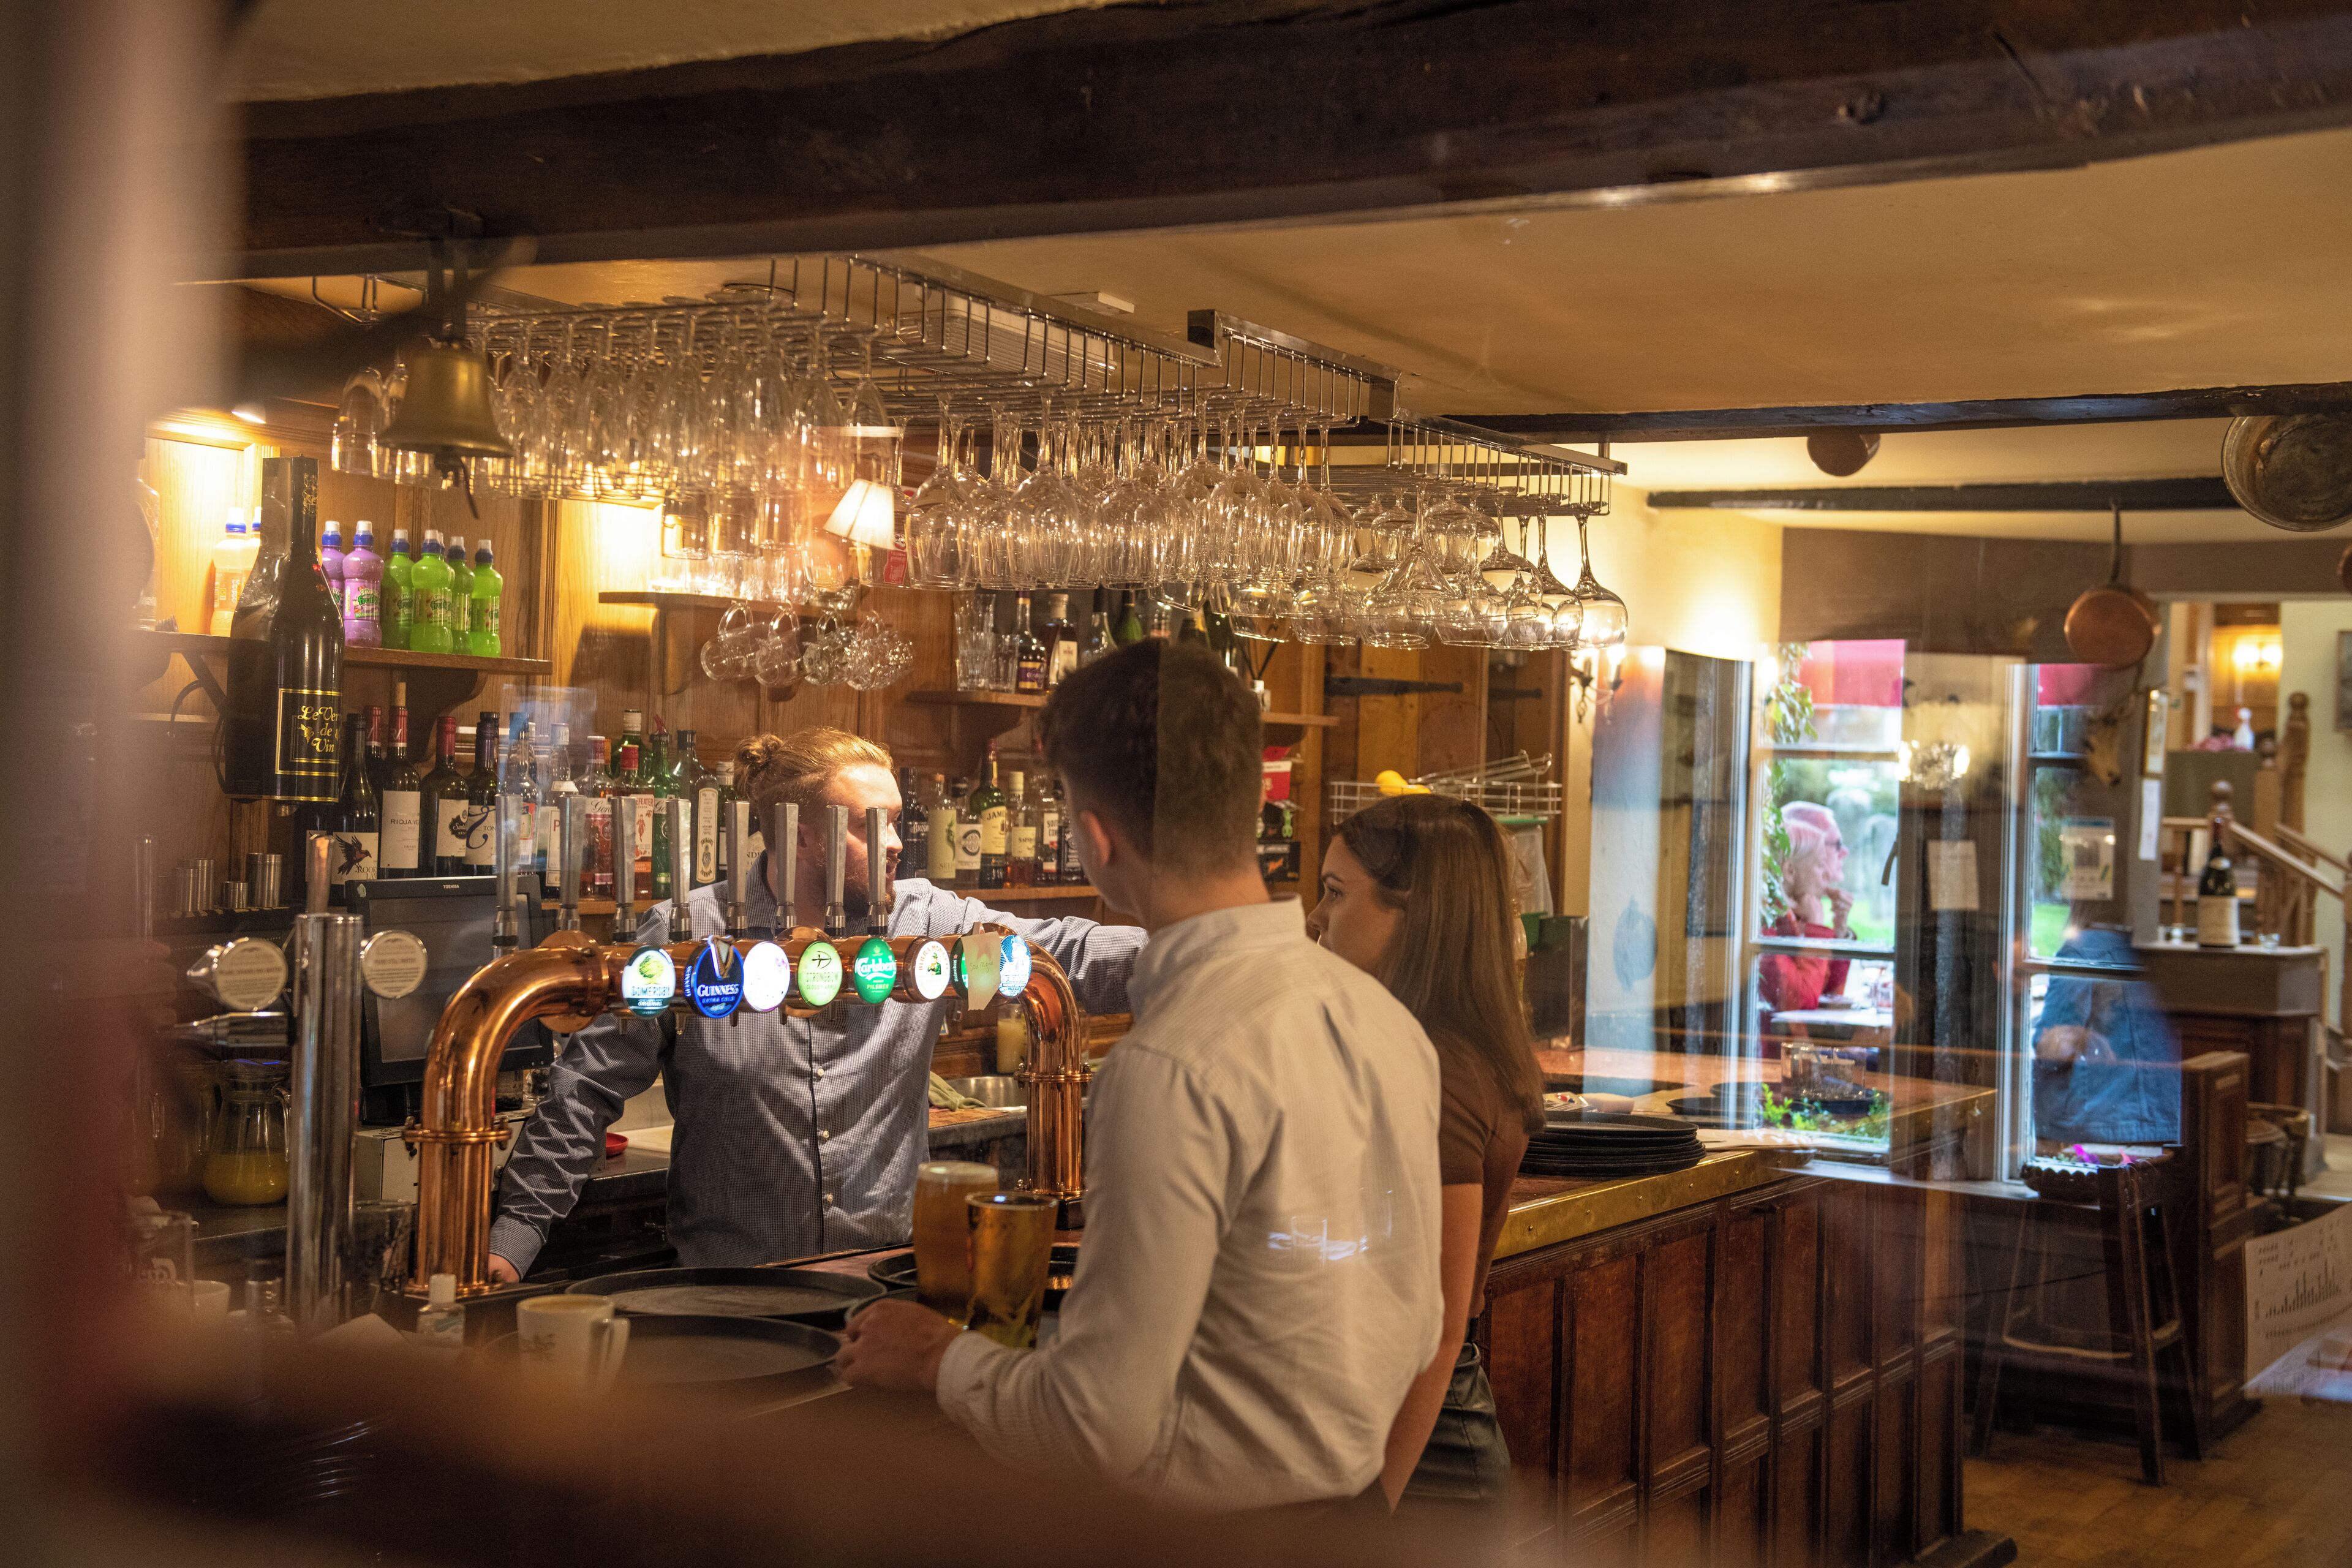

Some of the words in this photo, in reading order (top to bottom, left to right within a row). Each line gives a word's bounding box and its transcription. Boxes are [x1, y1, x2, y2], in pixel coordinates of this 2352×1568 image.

[297, 706, 318, 720] Le
[320, 723, 333, 736] de
[311, 737, 334, 752] Vin
[636, 798, 653, 807] EFEATER
[697, 983, 740, 997] GUINNESS
